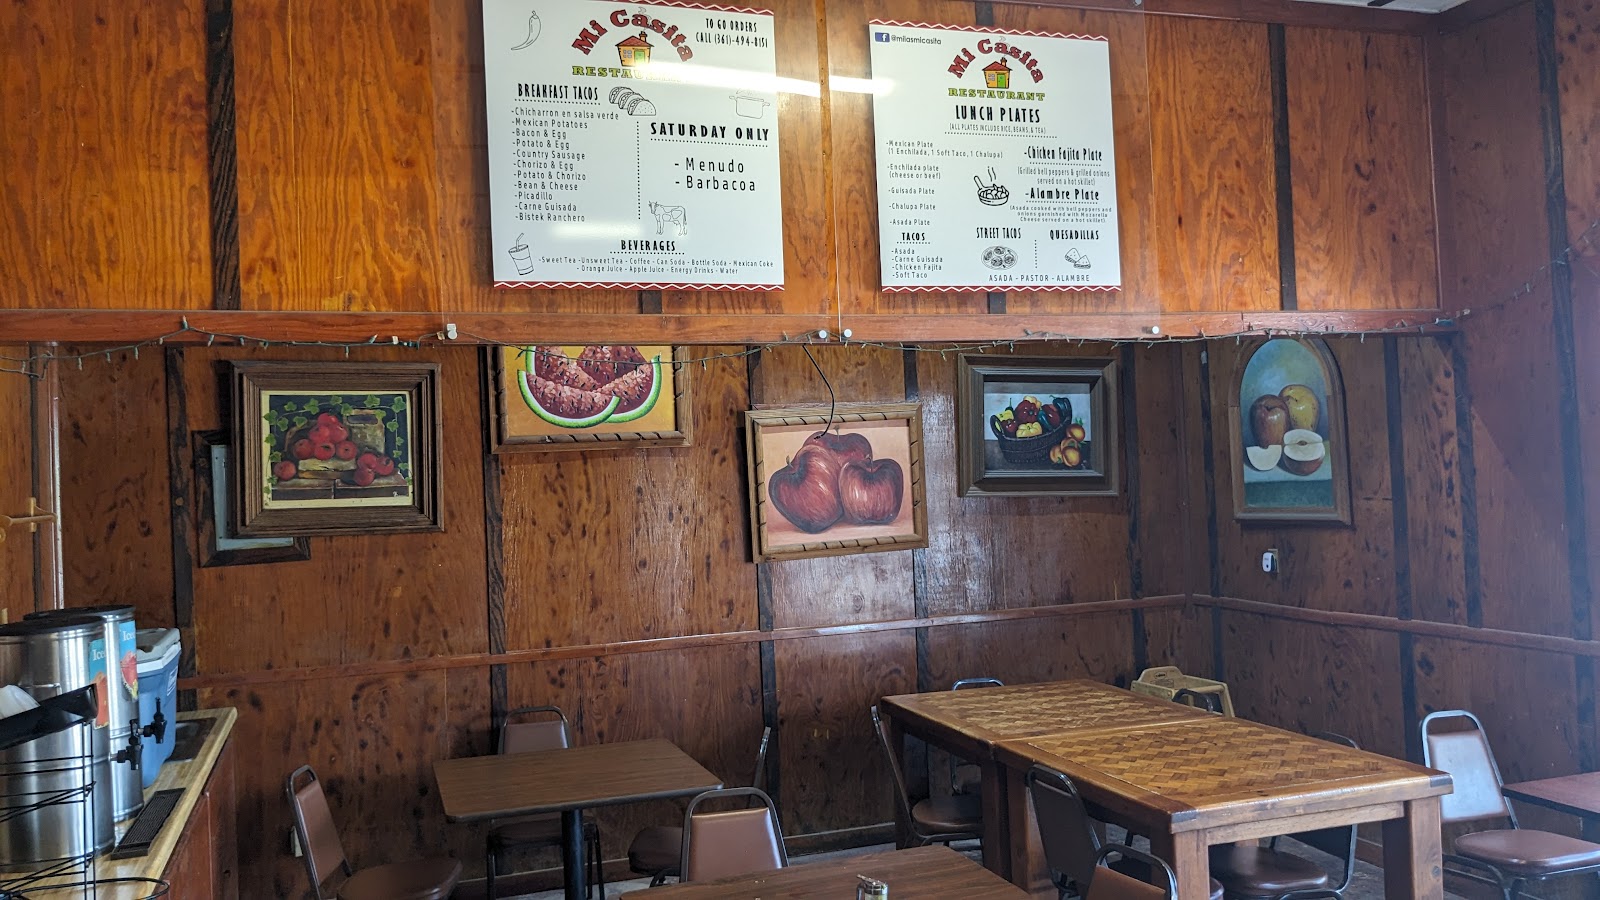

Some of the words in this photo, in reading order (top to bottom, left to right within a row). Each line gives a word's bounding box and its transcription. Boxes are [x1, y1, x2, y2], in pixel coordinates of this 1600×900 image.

[706, 18, 714, 28] TO
[717, 19, 726, 30] GO
[730, 20, 757, 32] ORDERS
[571, 19, 608, 56] Mi
[609, 9, 694, 62] Casita
[696, 32, 711, 43] CALL
[948, 48, 976, 78] Mi
[977, 38, 1044, 84] Casita
[518, 83, 568, 99] BREAKFAST
[572, 86, 598, 100] TACOS
[948, 88, 1045, 101] RESTAURANT
[562, 110, 571, 118] en
[574, 110, 594, 119] salsa
[597, 112, 619, 120] verde
[956, 105, 993, 121] LUNCH
[1000, 107, 1040, 123] PLATES
[552, 119, 588, 129] Potatoes
[544, 129, 548, 137] &
[552, 130, 567, 139] Egg
[650, 122, 726, 138] SATURDAY
[735, 127, 769, 141] ONLY
[546, 140, 552, 148] &
[555, 140, 570, 150] Egg
[552, 150, 586, 161] Sausage
[896, 148, 930, 156] Enchilada,
[975, 151, 1003, 159] Chalupa)
[1059, 147, 1079, 161] Fajita
[1083, 148, 1102, 161] Plate
[550, 161, 556, 169] &
[559, 161, 574, 171] Egg
[686, 157, 744, 173] Menudo
[548, 171, 553, 179] &
[556, 171, 586, 180] Chorizo
[1076, 169, 1092, 177] grilled
[541, 181, 546, 190] &
[549, 182, 578, 191] Cheese
[686, 175, 756, 191] Barbacoa
[1075, 189, 1099, 200] Plate
[545, 203, 577, 212] Guisada
[548, 213, 585, 222] Ranchero
[902, 232, 926, 241] TACOS
[976, 227, 999, 239] STREET
[1002, 228, 1022, 239] TACOS
[1050, 229, 1100, 240] QUESADILLAS
[620, 240, 676, 251] BEVERAGES
[581, 265, 604, 273] Orange
[629, 266, 647, 274] Apple
[92, 649, 106, 661] Ice
